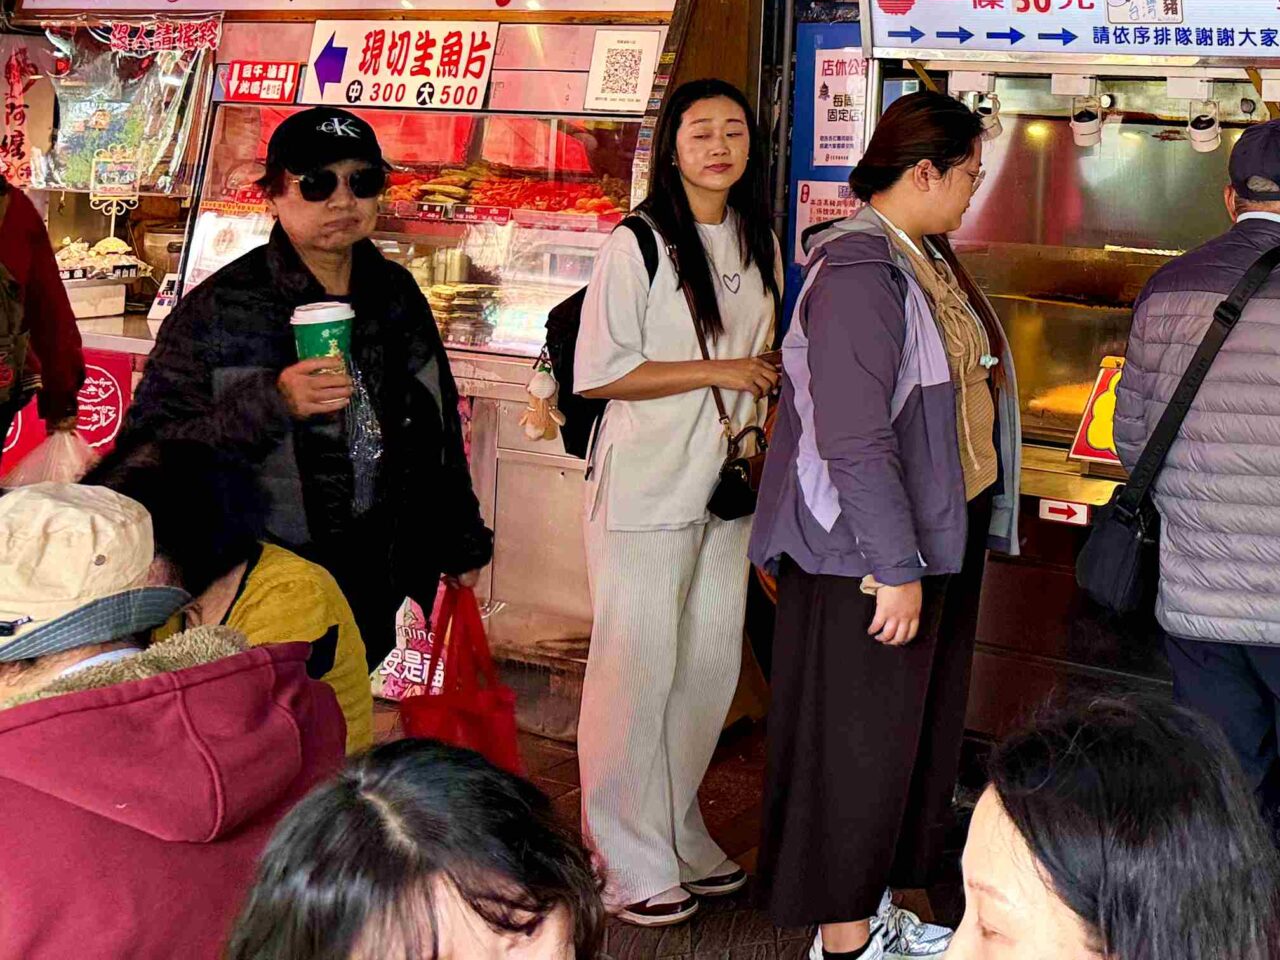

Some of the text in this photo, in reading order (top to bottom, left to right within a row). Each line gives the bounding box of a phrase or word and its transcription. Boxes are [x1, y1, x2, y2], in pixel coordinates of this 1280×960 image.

[1093, 25, 1280, 48] 請依序排隊謝謝大家
[358, 28, 491, 80] 現切生魚片
[369, 83, 406, 102] 300
[417, 83, 434, 105] 大
[440, 85, 478, 106] 500
